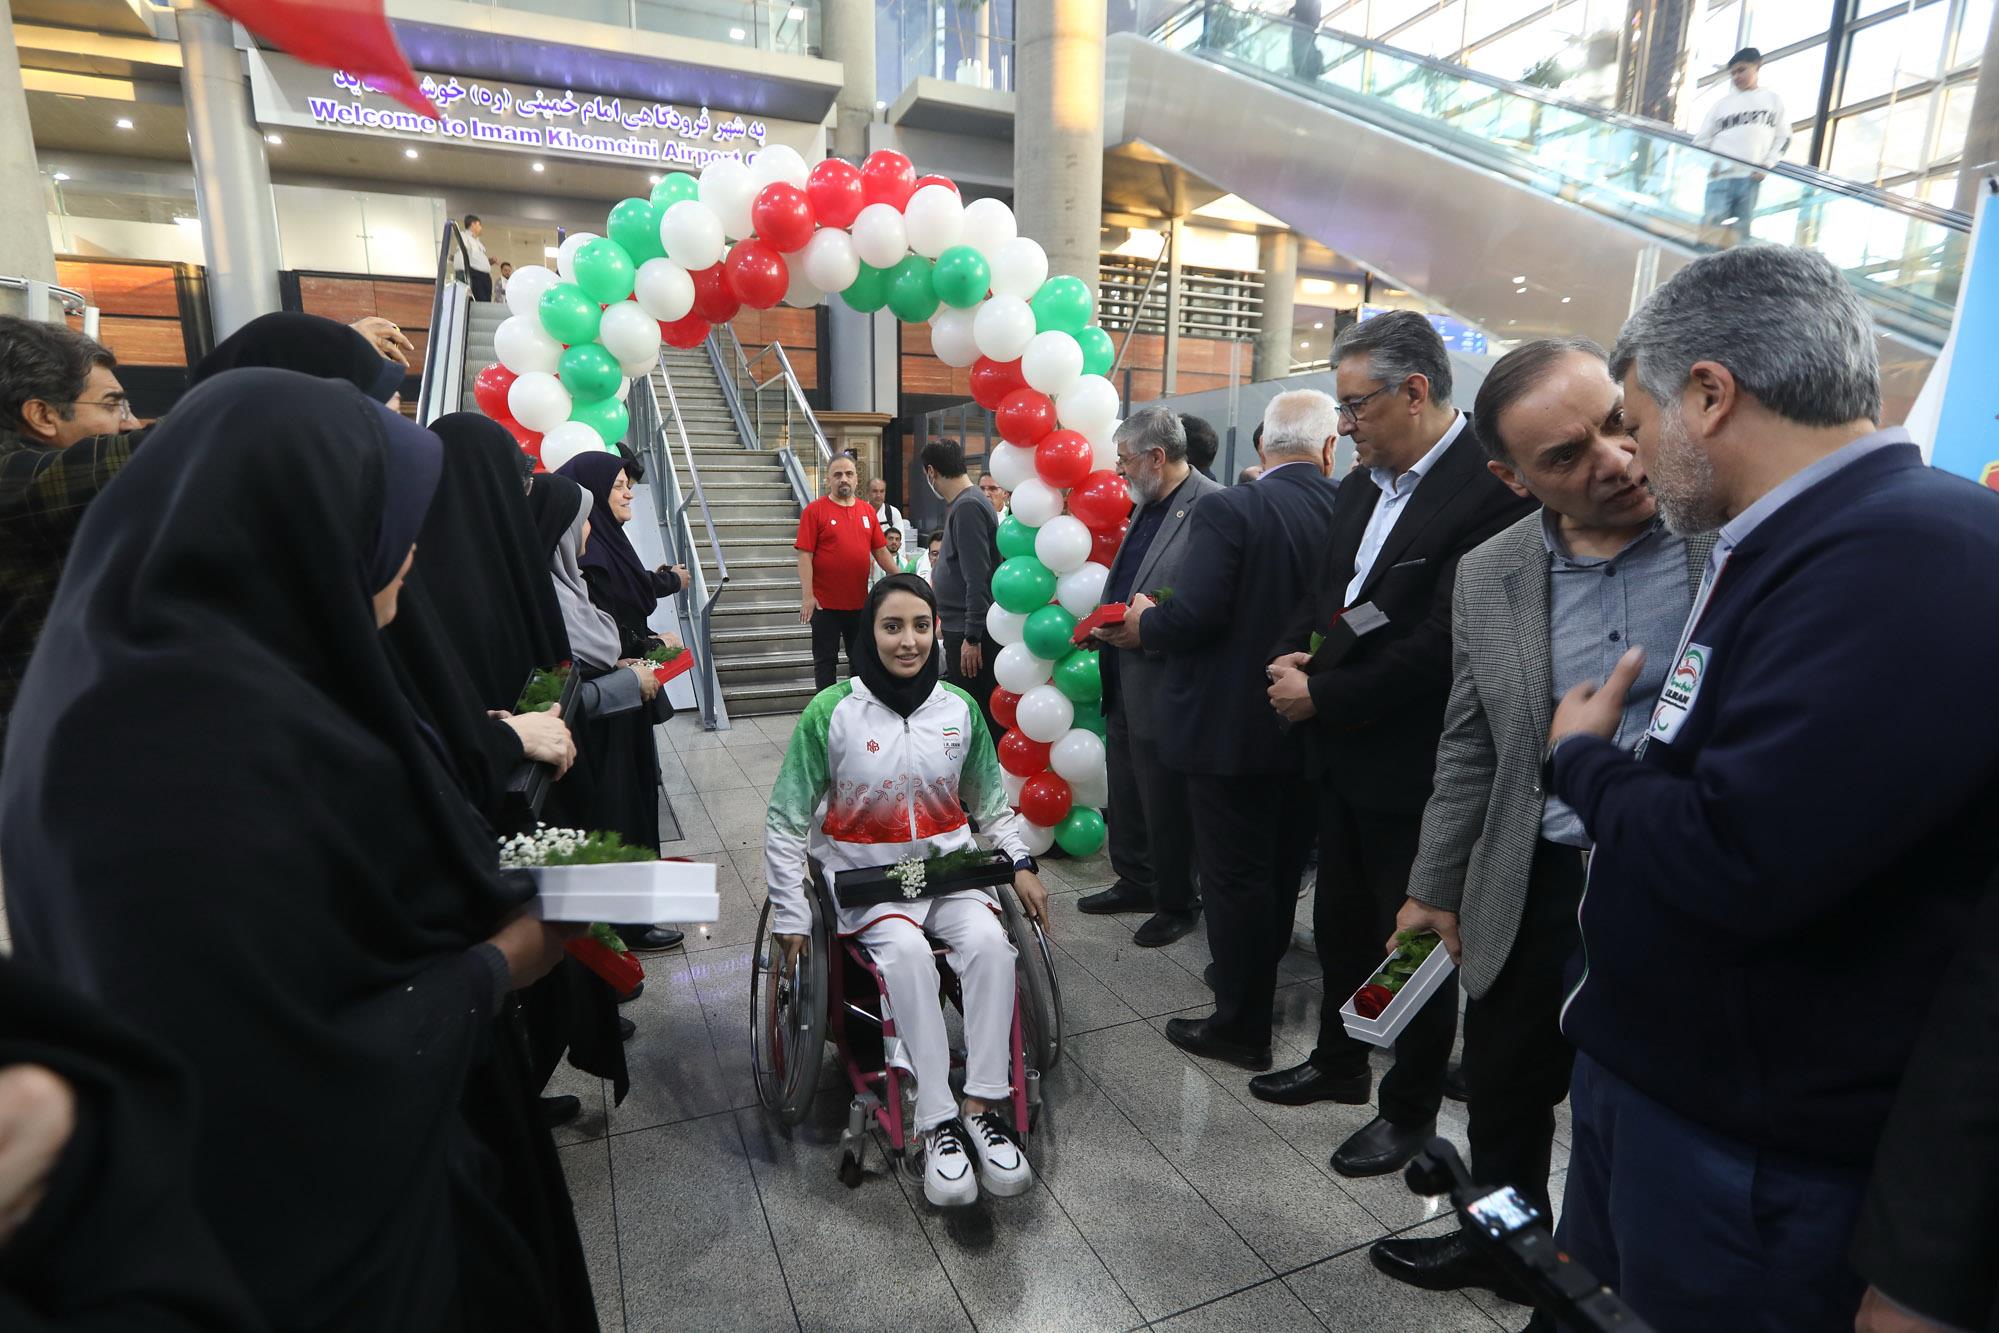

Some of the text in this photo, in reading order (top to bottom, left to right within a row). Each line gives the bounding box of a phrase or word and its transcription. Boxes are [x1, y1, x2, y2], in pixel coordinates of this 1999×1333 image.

[516, 90, 579, 119] خمینی
[582, 96, 620, 125] امام
[308, 97, 436, 133] Welcome
[440, 115, 467, 137] to
[470, 117, 541, 146] Imam
[546, 126, 658, 160] Khomeini
[622, 104, 710, 138] فرودگاهی
[713, 116, 746, 141] شهر
[748, 121, 765, 146] به
